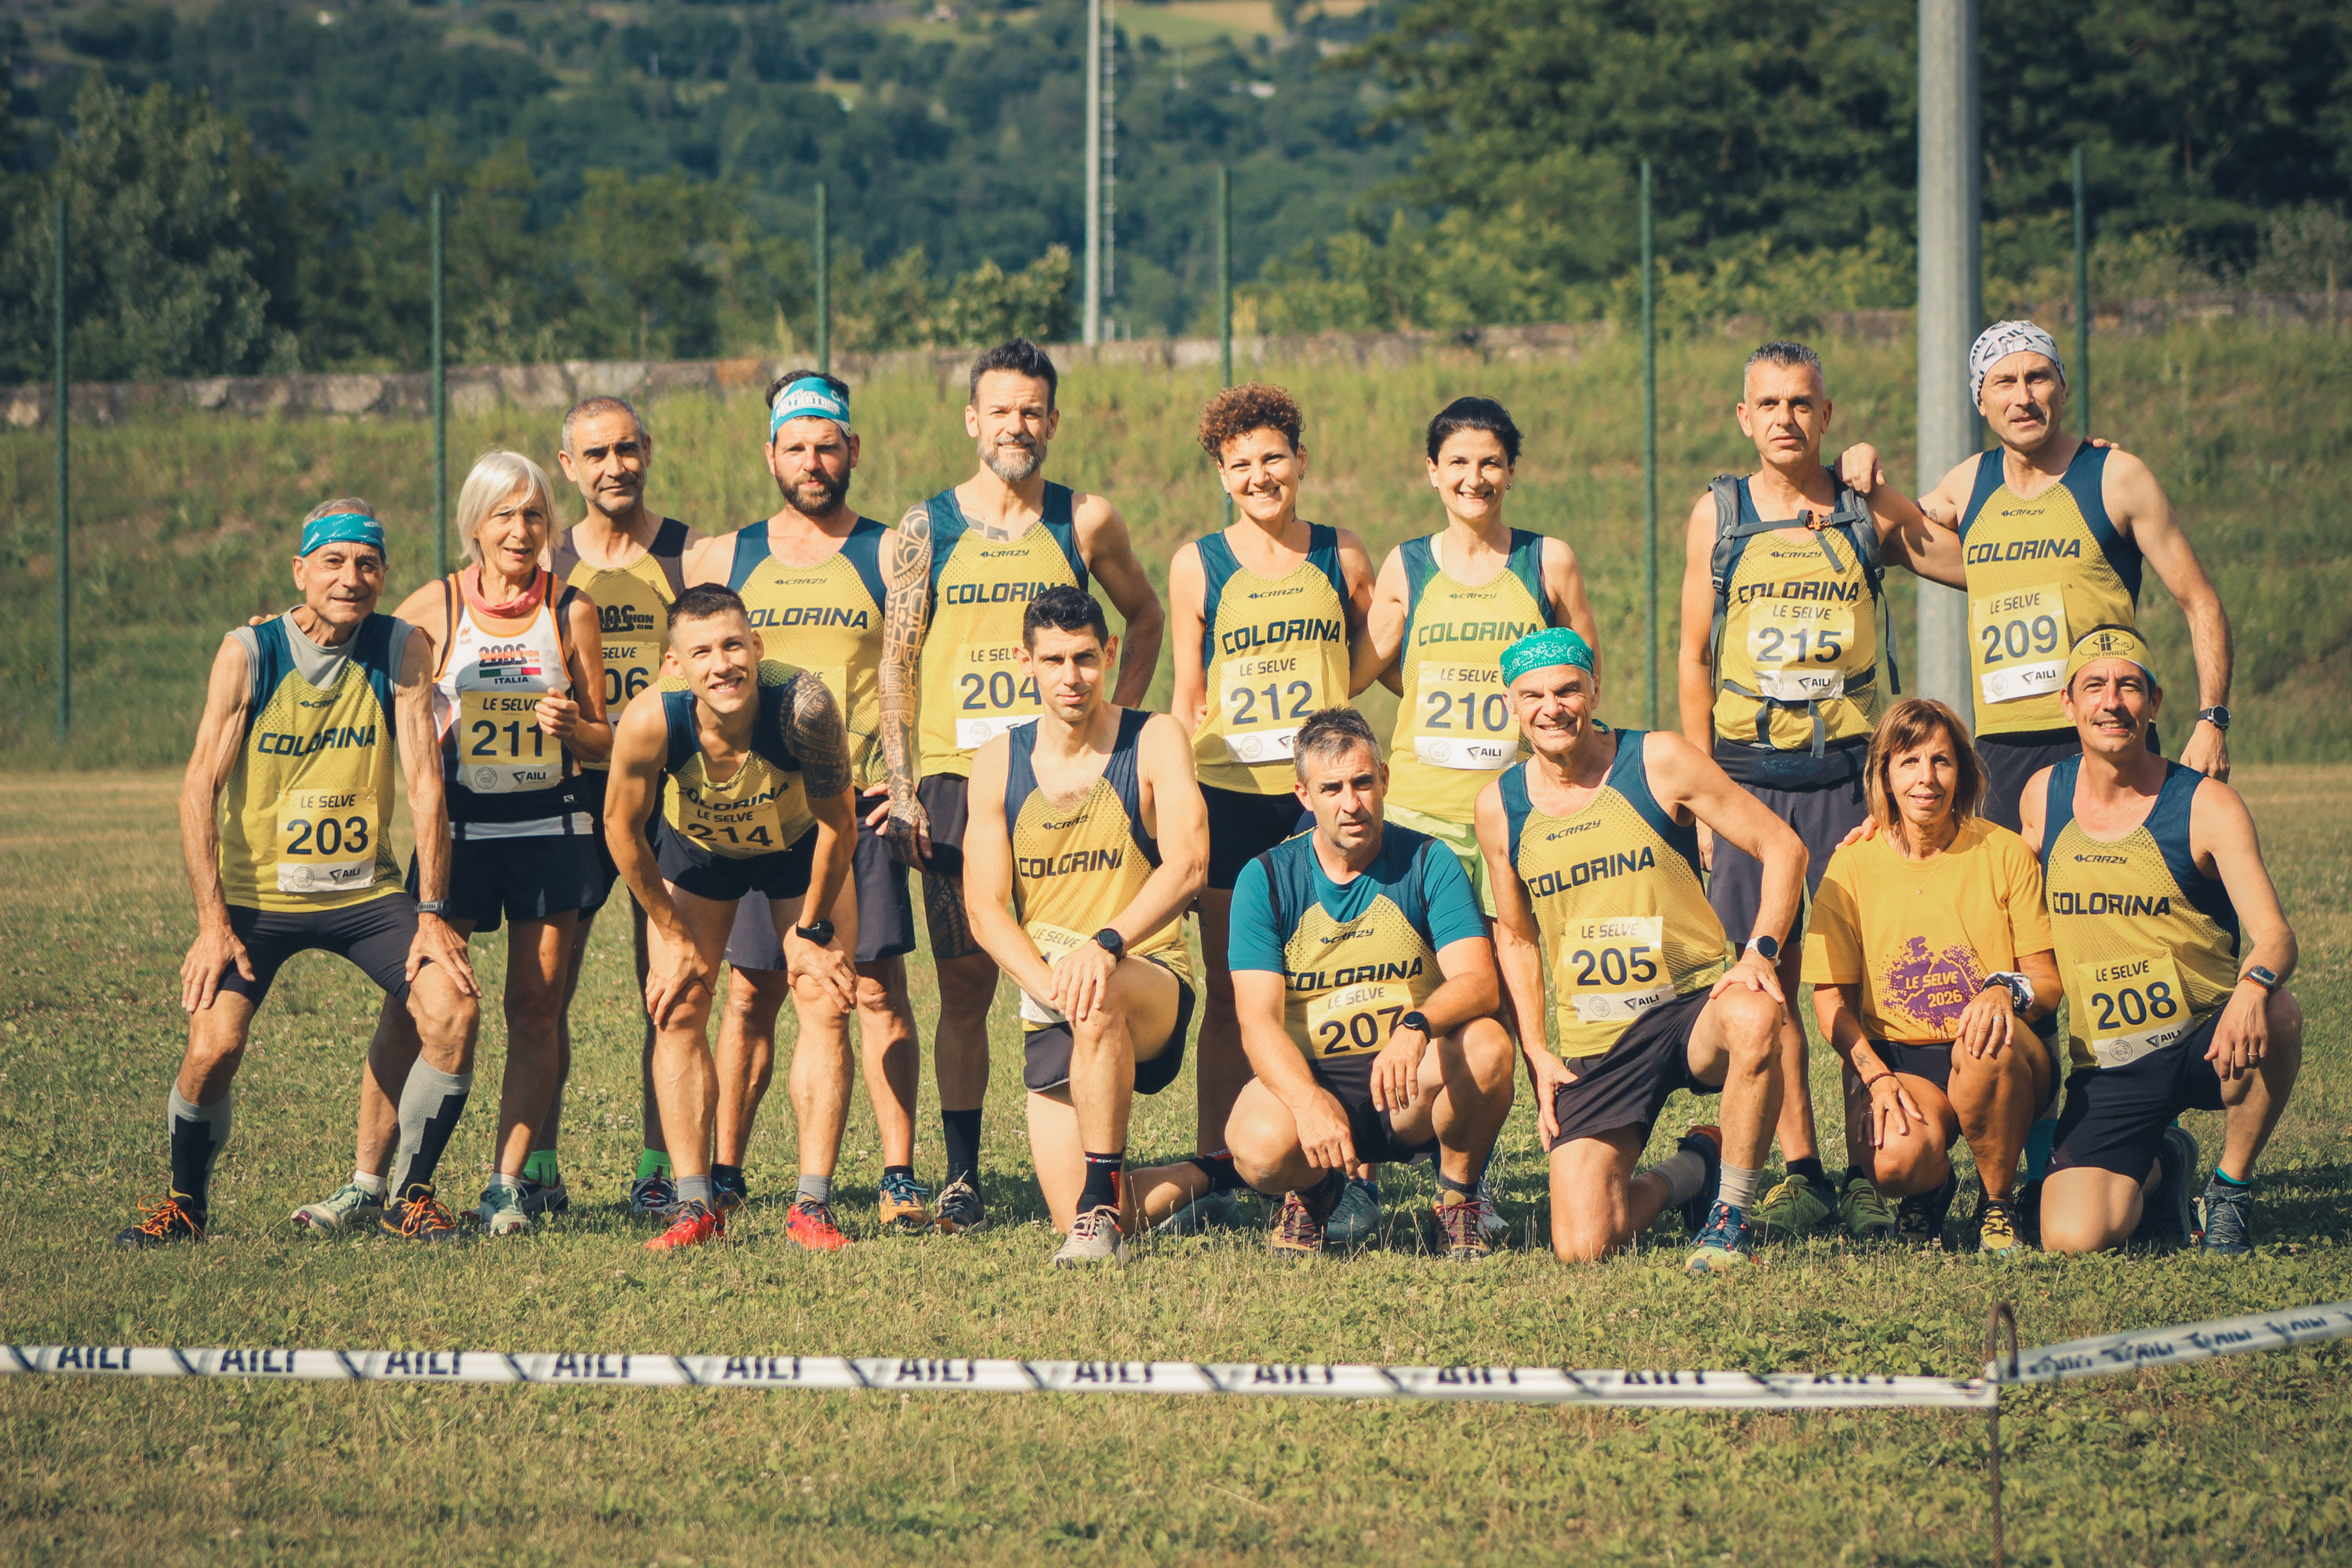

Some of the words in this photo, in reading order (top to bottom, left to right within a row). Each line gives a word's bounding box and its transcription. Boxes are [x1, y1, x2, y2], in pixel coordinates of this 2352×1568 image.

[990, 549, 1029, 557] CRAZY
[1780, 550, 1823, 559] CRAZY
[1967, 539, 2081, 565] COLORINA
[1259, 587, 1304, 598] CRAZY
[1738, 581, 1859, 603] COLORINA
[1773, 604, 1786, 617] LE
[1791, 606, 1831, 620] SELVE
[1991, 600, 2000, 614] LE
[2004, 593, 2040, 611] SELVE
[747, 608, 868, 630] OLORINA
[1221, 619, 1341, 655] COLORINA
[1757, 627, 1842, 662] 215
[1982, 615, 2058, 664] 209
[602, 647, 637, 659] SELVE
[971, 650, 985, 662] LE
[989, 648, 1017, 662] SEL
[1240, 663, 1253, 677] LE
[1258, 658, 1297, 674] SELVE
[1440, 668, 1454, 681] LE
[1458, 669, 1498, 684] SELVE
[2035, 670, 2056, 679] AILI
[605, 666, 650, 706] 06
[961, 671, 1042, 710] 204
[483, 698, 498, 710] LE
[501, 698, 541, 711] SELVE
[1230, 680, 1315, 725] 212
[1425, 691, 1509, 731] 210
[257, 724, 376, 757] COLORINA
[472, 720, 543, 757] 211
[1480, 748, 1501, 757] AILI
[526, 771, 546, 781] AILI
[300, 796, 314, 808] LE
[318, 793, 356, 808] SELVE
[697, 808, 710, 820] LE
[713, 811, 753, 822] SELVE
[286, 816, 368, 855] 203
[688, 823, 774, 847] 214
[1557, 819, 1601, 838] CRAZY
[2084, 855, 2128, 864] CRAZY
[342, 868, 361, 878] AILI
[1528, 846, 1656, 898] COLORINA
[2053, 891, 2171, 916] COLORINA
[1033, 928, 1047, 940] LE
[1047, 931, 1080, 949] SELVE
[1331, 927, 1374, 944] CRAZY
[1581, 926, 1595, 938] LE
[1599, 922, 1639, 938] SELVE
[1571, 946, 1657, 986] 205
[2096, 967, 2108, 982] LE
[2111, 960, 2150, 980] SELVE
[1905, 975, 1920, 990] LE
[1922, 971, 1958, 989] SELVE
[1328, 996, 1341, 1010] LE
[1345, 986, 1385, 1005] SELVE
[1639, 994, 1660, 1006] AILI
[1927, 989, 1963, 1007] 2026
[2091, 982, 2177, 1031] 208
[1319, 1004, 1406, 1055] 207
[56, 1347, 132, 1370] AILI
[220, 1349, 296, 1373] AILI
[384, 1352, 462, 1375] AILI
[552, 1354, 631, 1377] AILI
[723, 1356, 802, 1380] AILI
[895, 1359, 976, 1382] AILI
[1073, 1362, 1154, 1384] AILI
